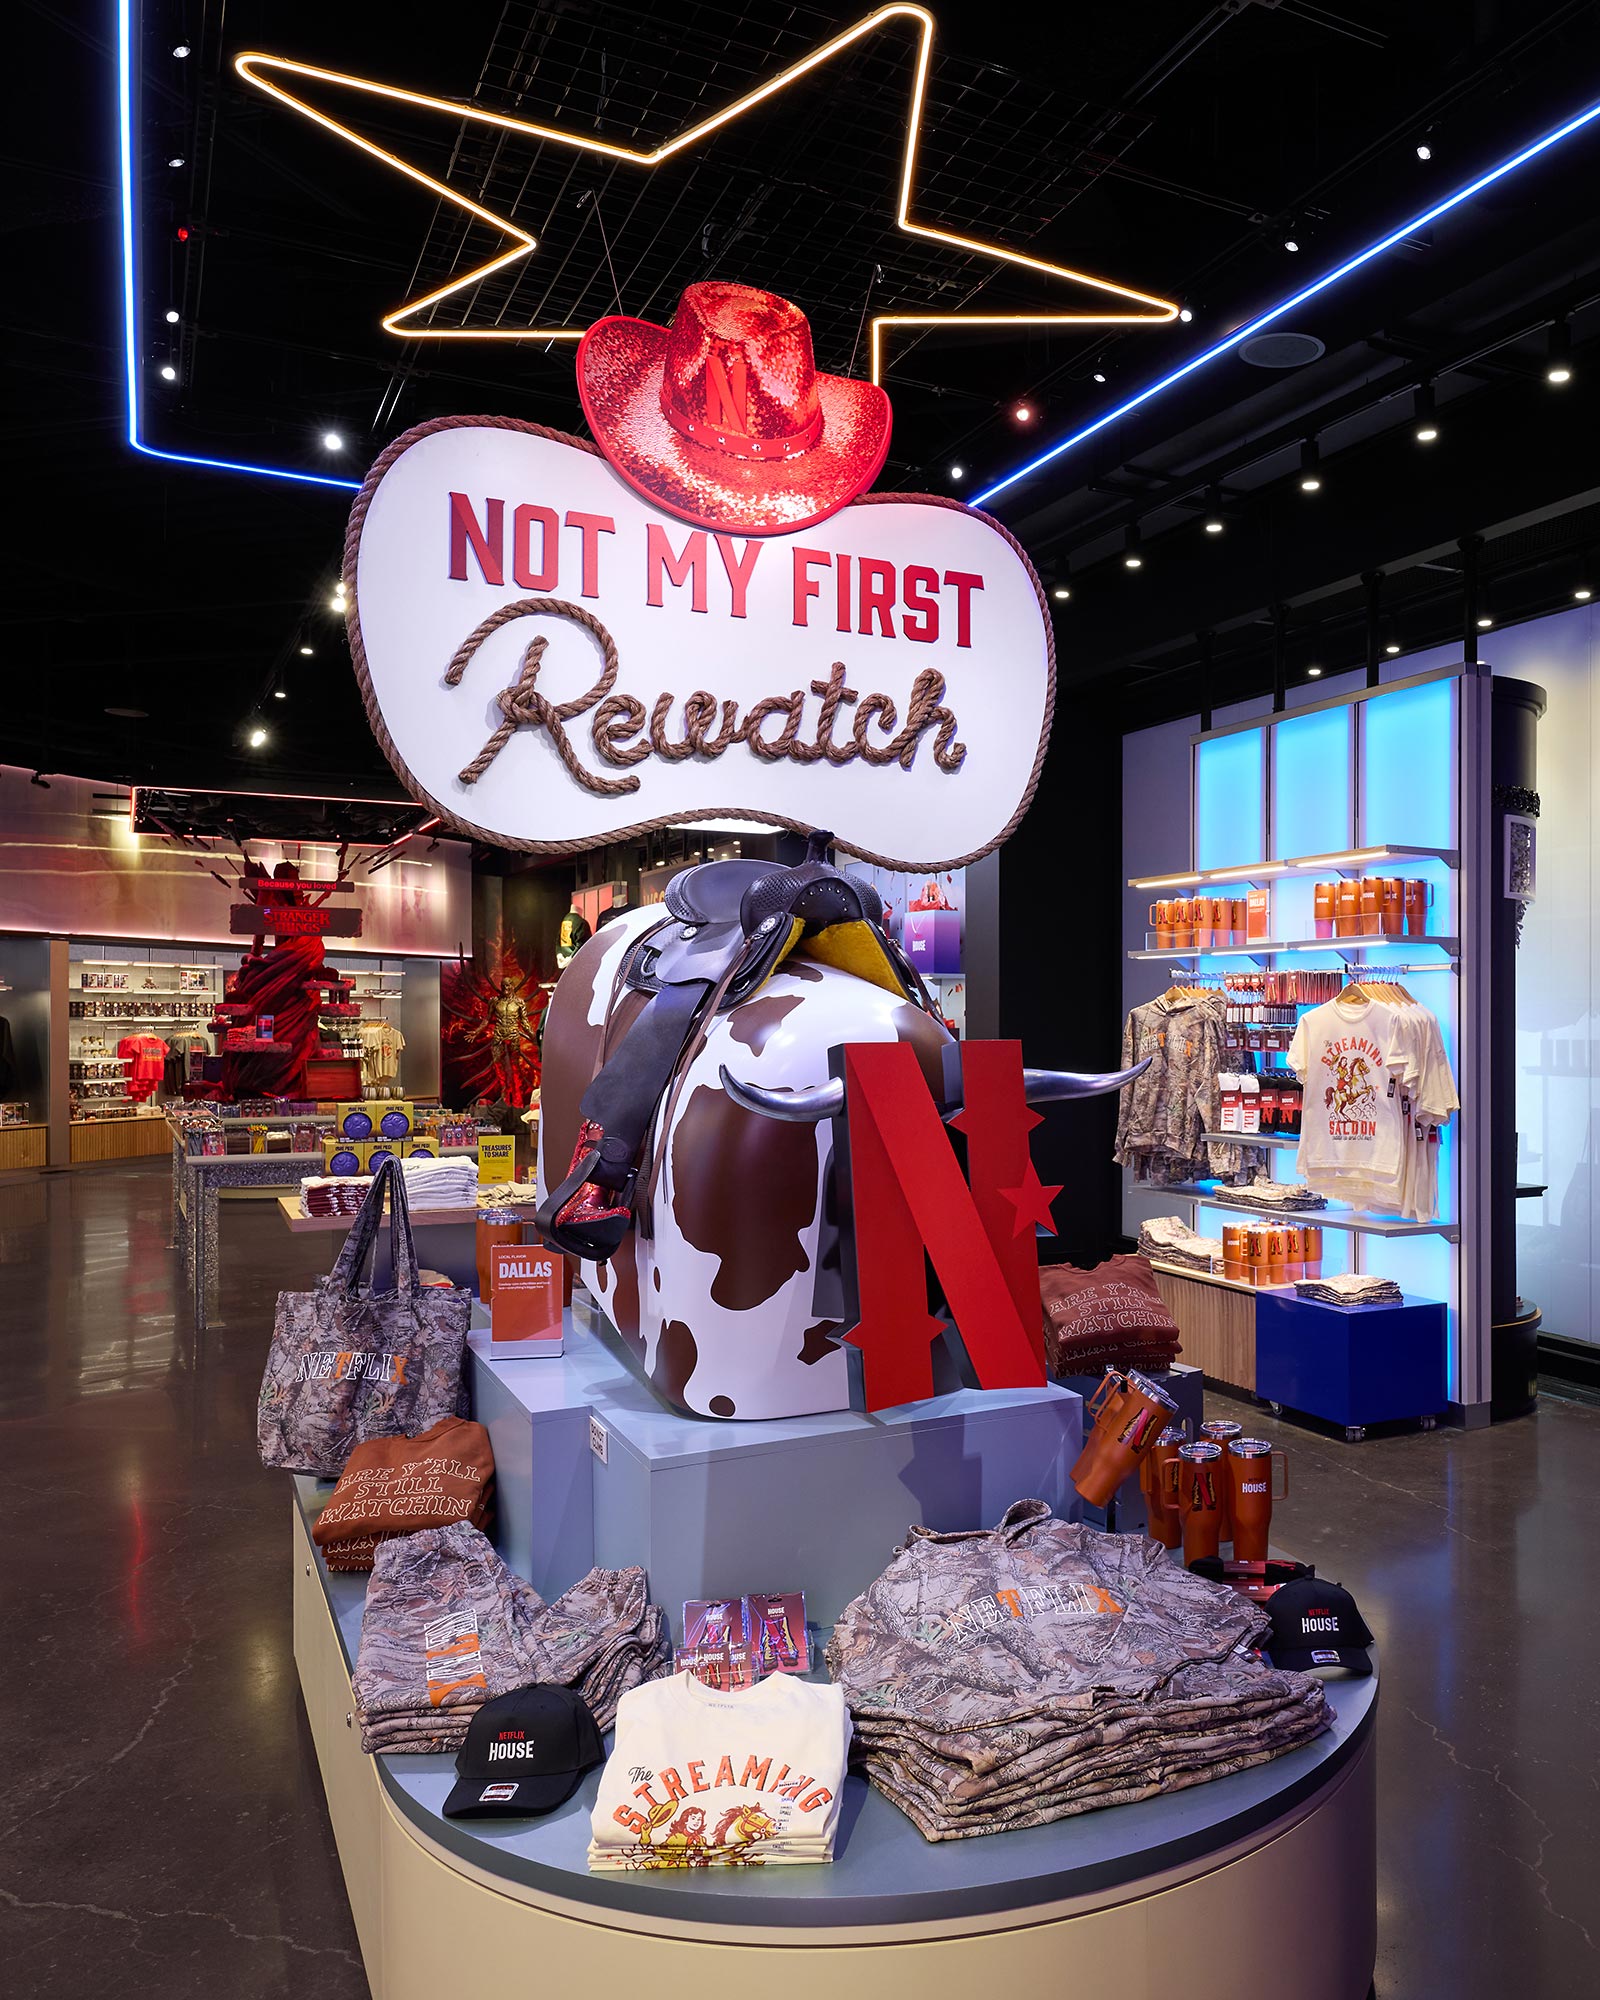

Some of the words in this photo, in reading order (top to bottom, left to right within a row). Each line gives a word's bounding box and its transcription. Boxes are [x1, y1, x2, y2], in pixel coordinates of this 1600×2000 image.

[448, 491, 615, 599] NOT
[647, 523, 764, 619] MY
[792, 546, 985, 648] FIRST
[444, 597, 967, 797] Rewatch
[257, 879, 295, 889] Because
[296, 882, 312, 891] you
[314, 881, 337, 890] loved
[264, 910, 331, 927] STRANGER
[275, 922, 321, 933] THINGS
[1329, 1120, 1376, 1136] SALOON
[499, 1261, 552, 1279] DALLAS
[1049, 1287, 1098, 1318] ARE
[296, 1351, 409, 1386] NETFLIX
[334, 1468, 395, 1496] ARE
[401, 1457, 481, 1483] Y'ALL
[354, 1476, 443, 1500] STILL
[1242, 1482, 1267, 1494] HOUSE
[318, 1495, 472, 1526] WATCHIN
[706, 1613, 724, 1621] HOUSE
[767, 1607, 785, 1615] HOUSE
[946, 1582, 1125, 1643] NETFLIX
[1308, 1609, 1330, 1617] NETFLIX
[1301, 1616, 1340, 1634] HOUSE
[703, 1653, 725, 1662] HOUSE
[498, 1730, 525, 1741] NETFLIX
[488, 1740, 535, 1762] HOUSE
[628, 1766, 654, 1785] The
[613, 1754, 833, 1835] STREAMING
